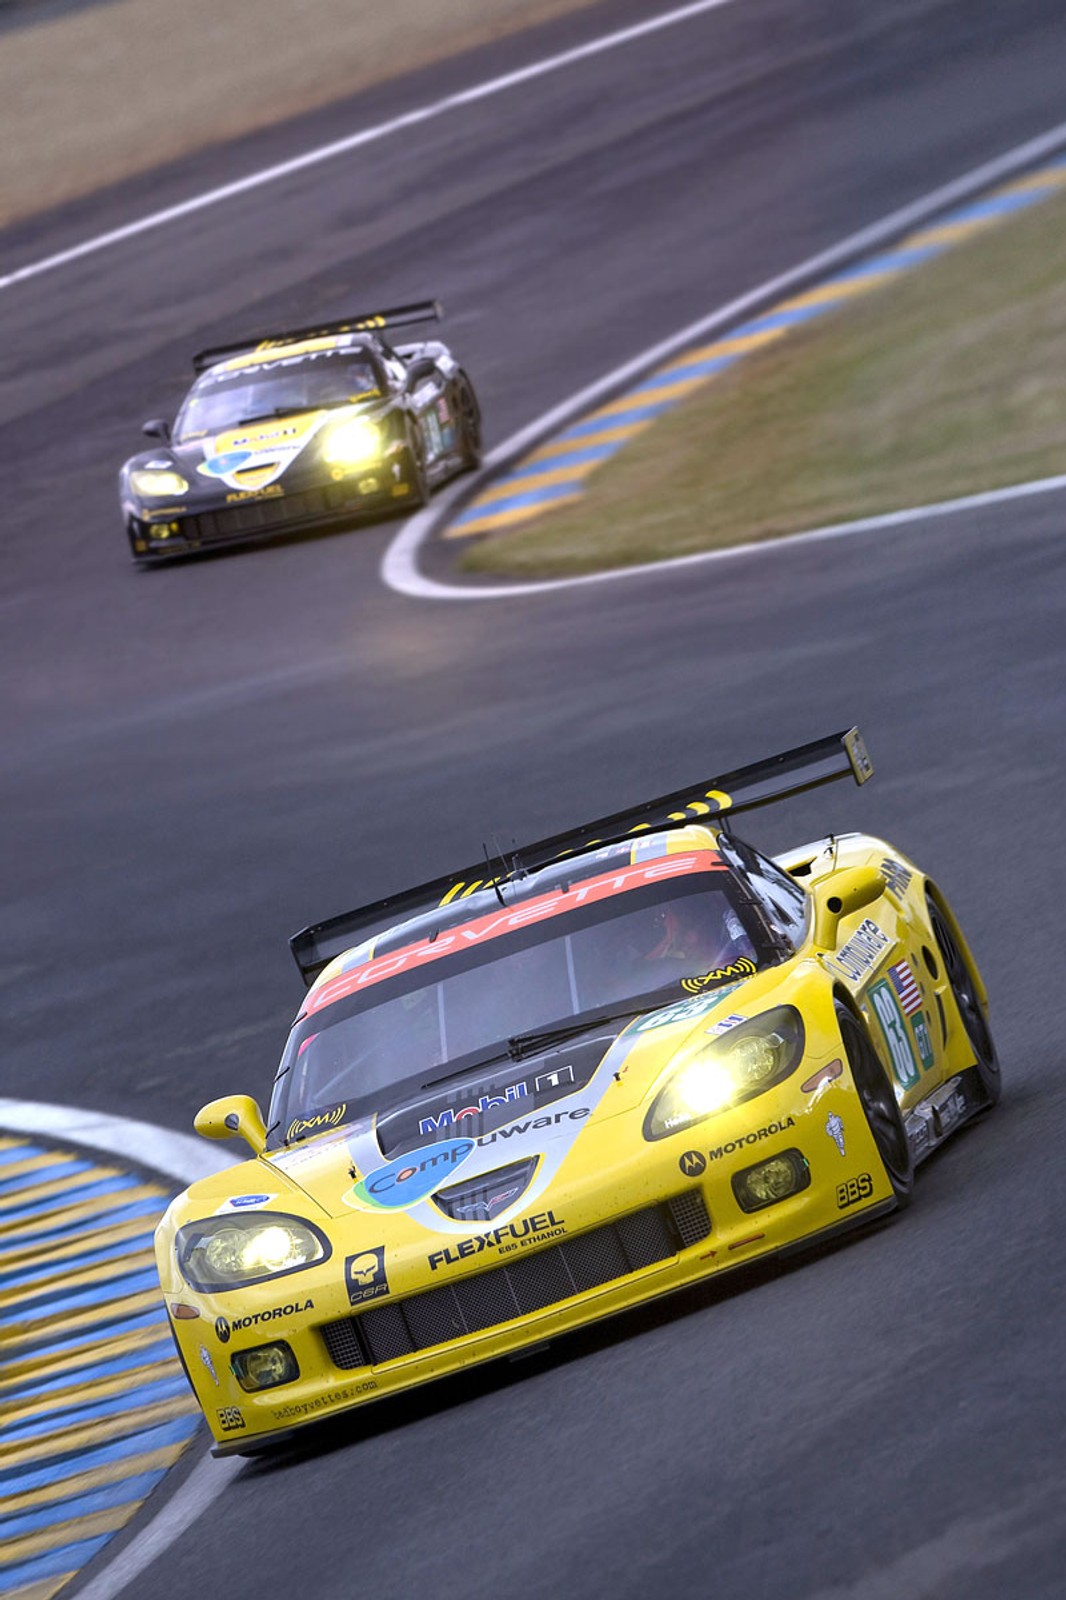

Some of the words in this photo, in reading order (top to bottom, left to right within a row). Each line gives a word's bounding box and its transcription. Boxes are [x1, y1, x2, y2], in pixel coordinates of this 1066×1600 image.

[312, 857, 697, 1009] CORVETTE
[419, 1082, 528, 1135] Mobil
[368, 1107, 592, 1194] Compuware
[709, 1116, 796, 1161] MOTOROLA
[836, 1172, 874, 1209] BBS
[427, 1210, 565, 1271] FLEXFUEL
[498, 1243, 518, 1255] E85
[520, 1227, 568, 1248] ETHANOL
[231, 1298, 315, 1332] MOTOROLA
[216, 1405, 246, 1432] BBS
